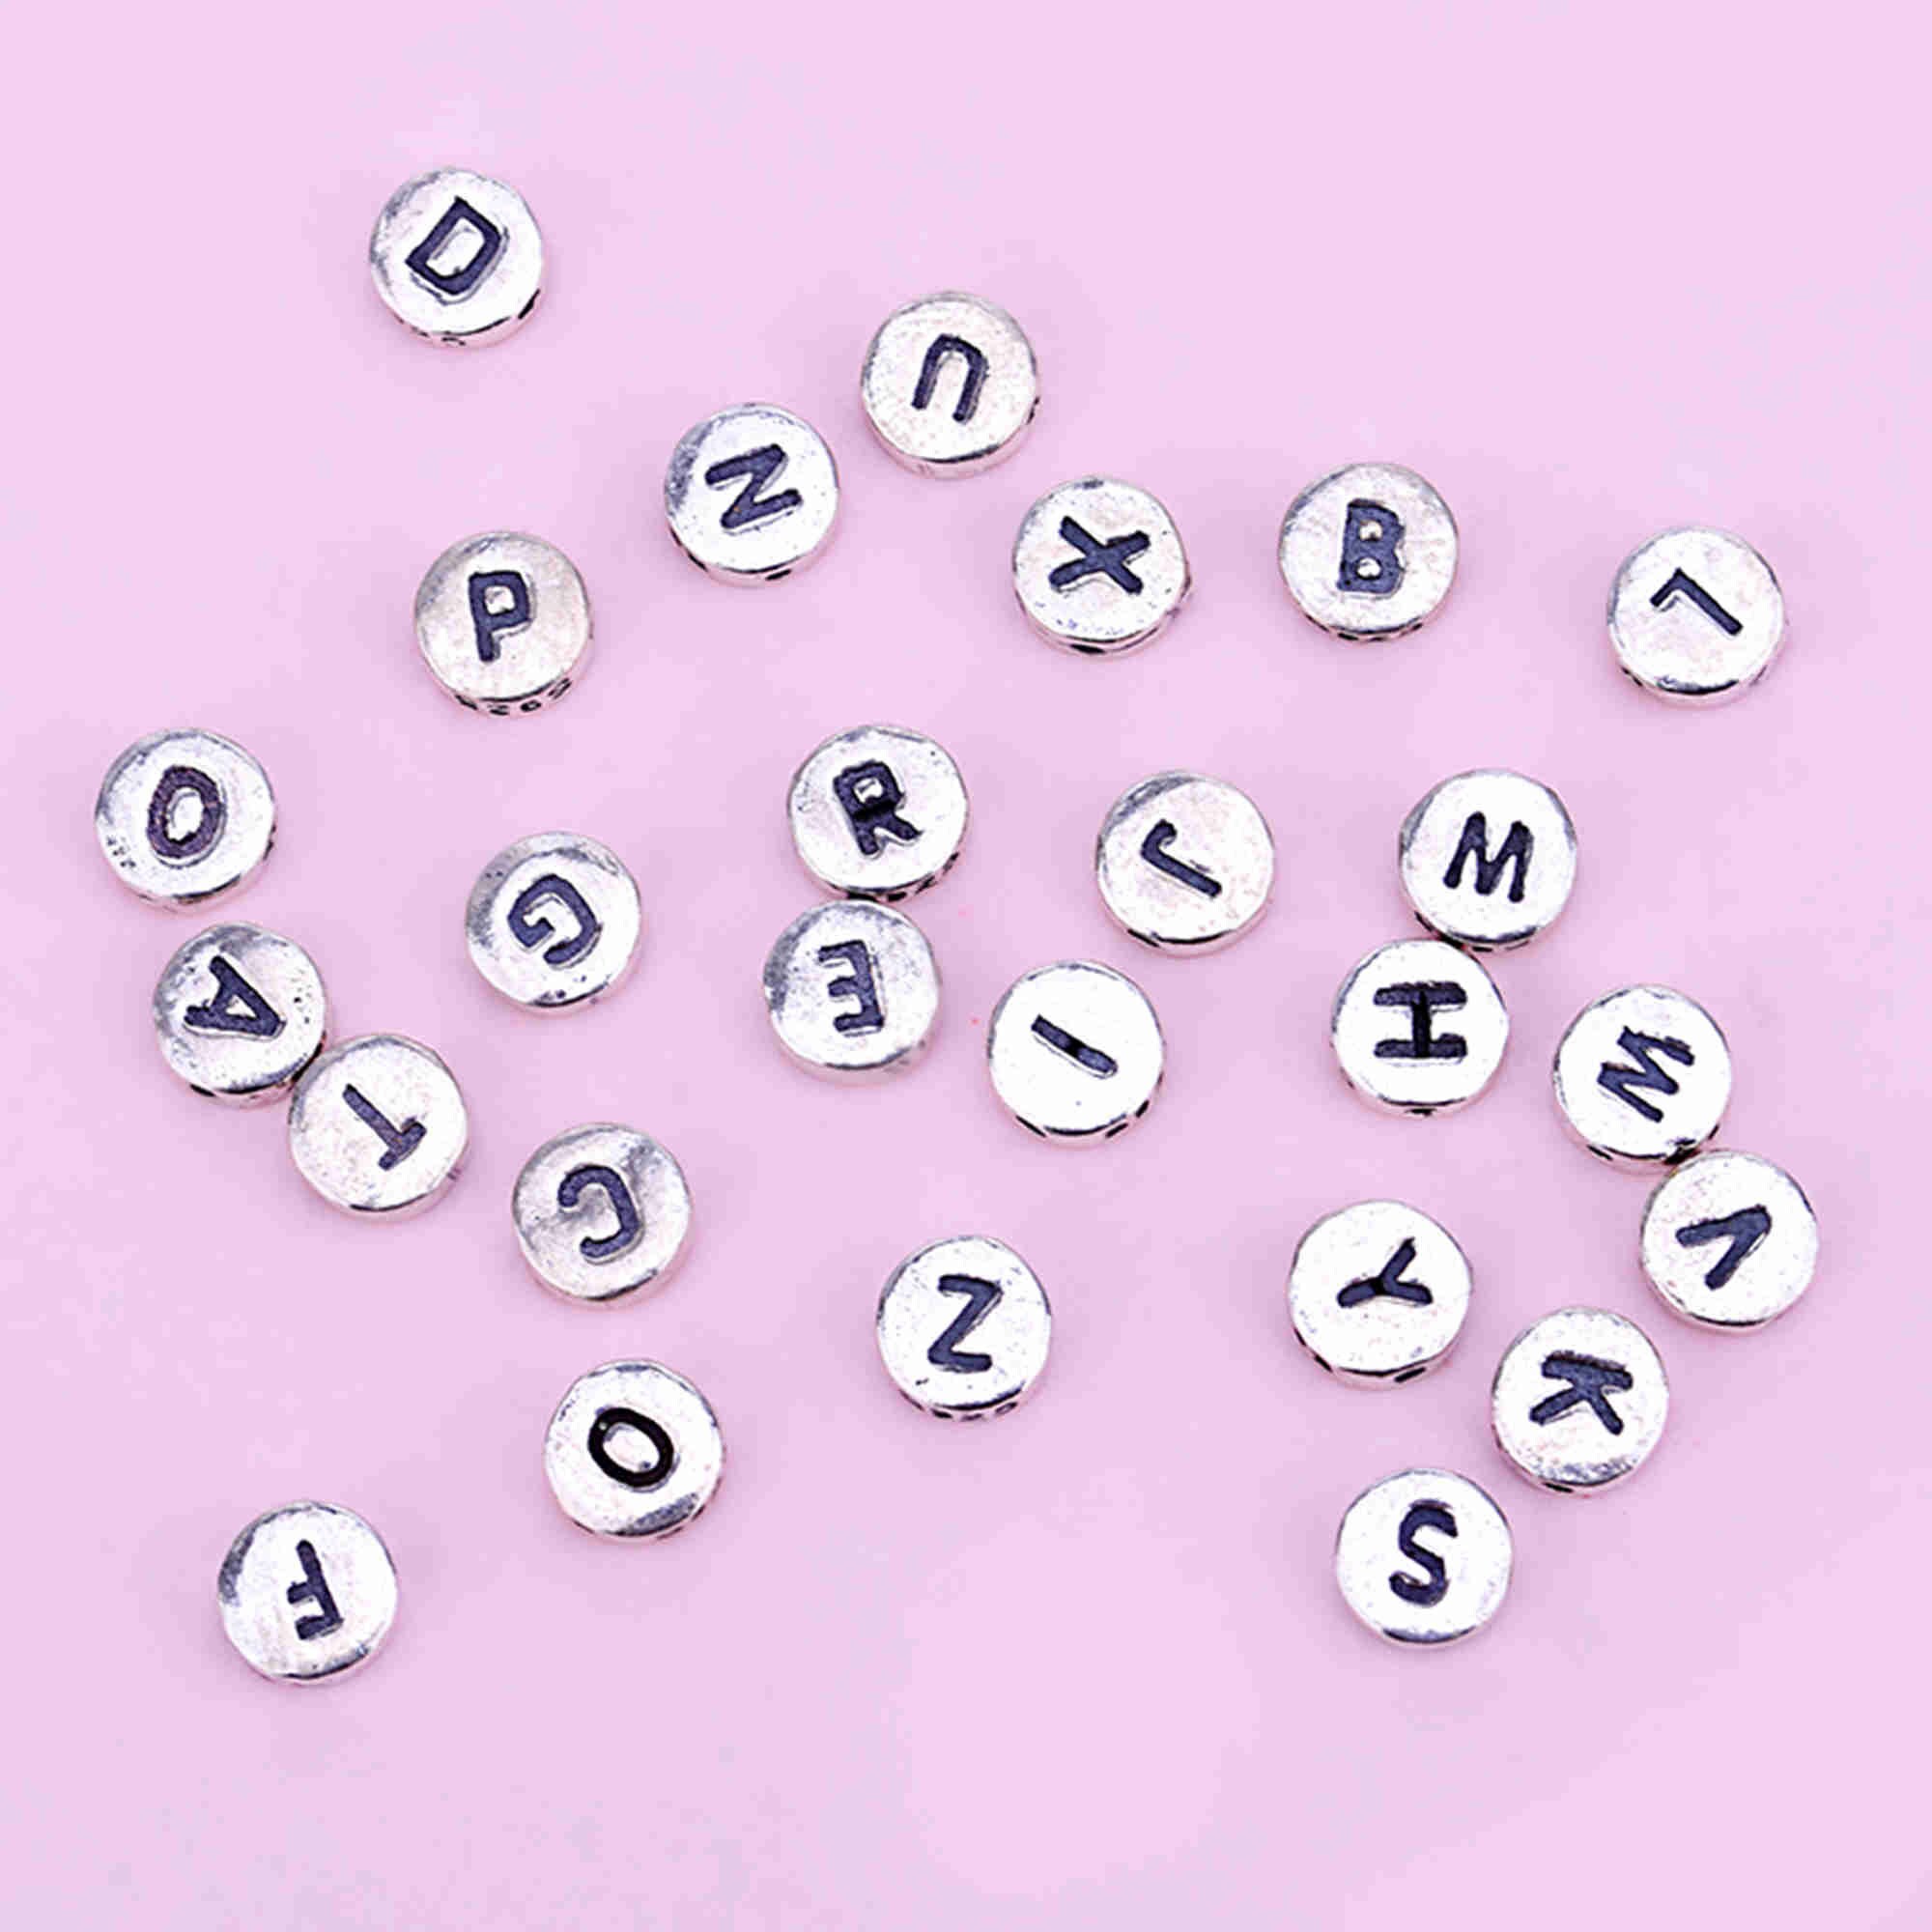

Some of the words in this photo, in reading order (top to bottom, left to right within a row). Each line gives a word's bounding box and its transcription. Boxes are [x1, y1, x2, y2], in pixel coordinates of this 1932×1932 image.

[404, 195, 503, 297] D
[911, 333, 990, 423] U
[1048, 515, 1151, 596] X
[1336, 497, 1406, 595] B
[468, 569, 534, 664] P
[1649, 567, 1744, 637] L
[146, 764, 228, 860] O
[832, 759, 923, 857] R
[1139, 818, 1223, 899] J
[506, 872, 603, 967] G
[183, 954, 287, 1038] A
[817, 939, 886, 1033] E
[1373, 980, 1468, 1064] H
[342, 1083, 427, 1172] T
[556, 1163, 645, 1259] C
[1336, 1236, 1434, 1309] Y
[926, 1273, 1005, 1375] Z
[1528, 1350, 1634, 1436] K
[286, 1539, 345, 1641] F
[1388, 1498, 1459, 1606] S
